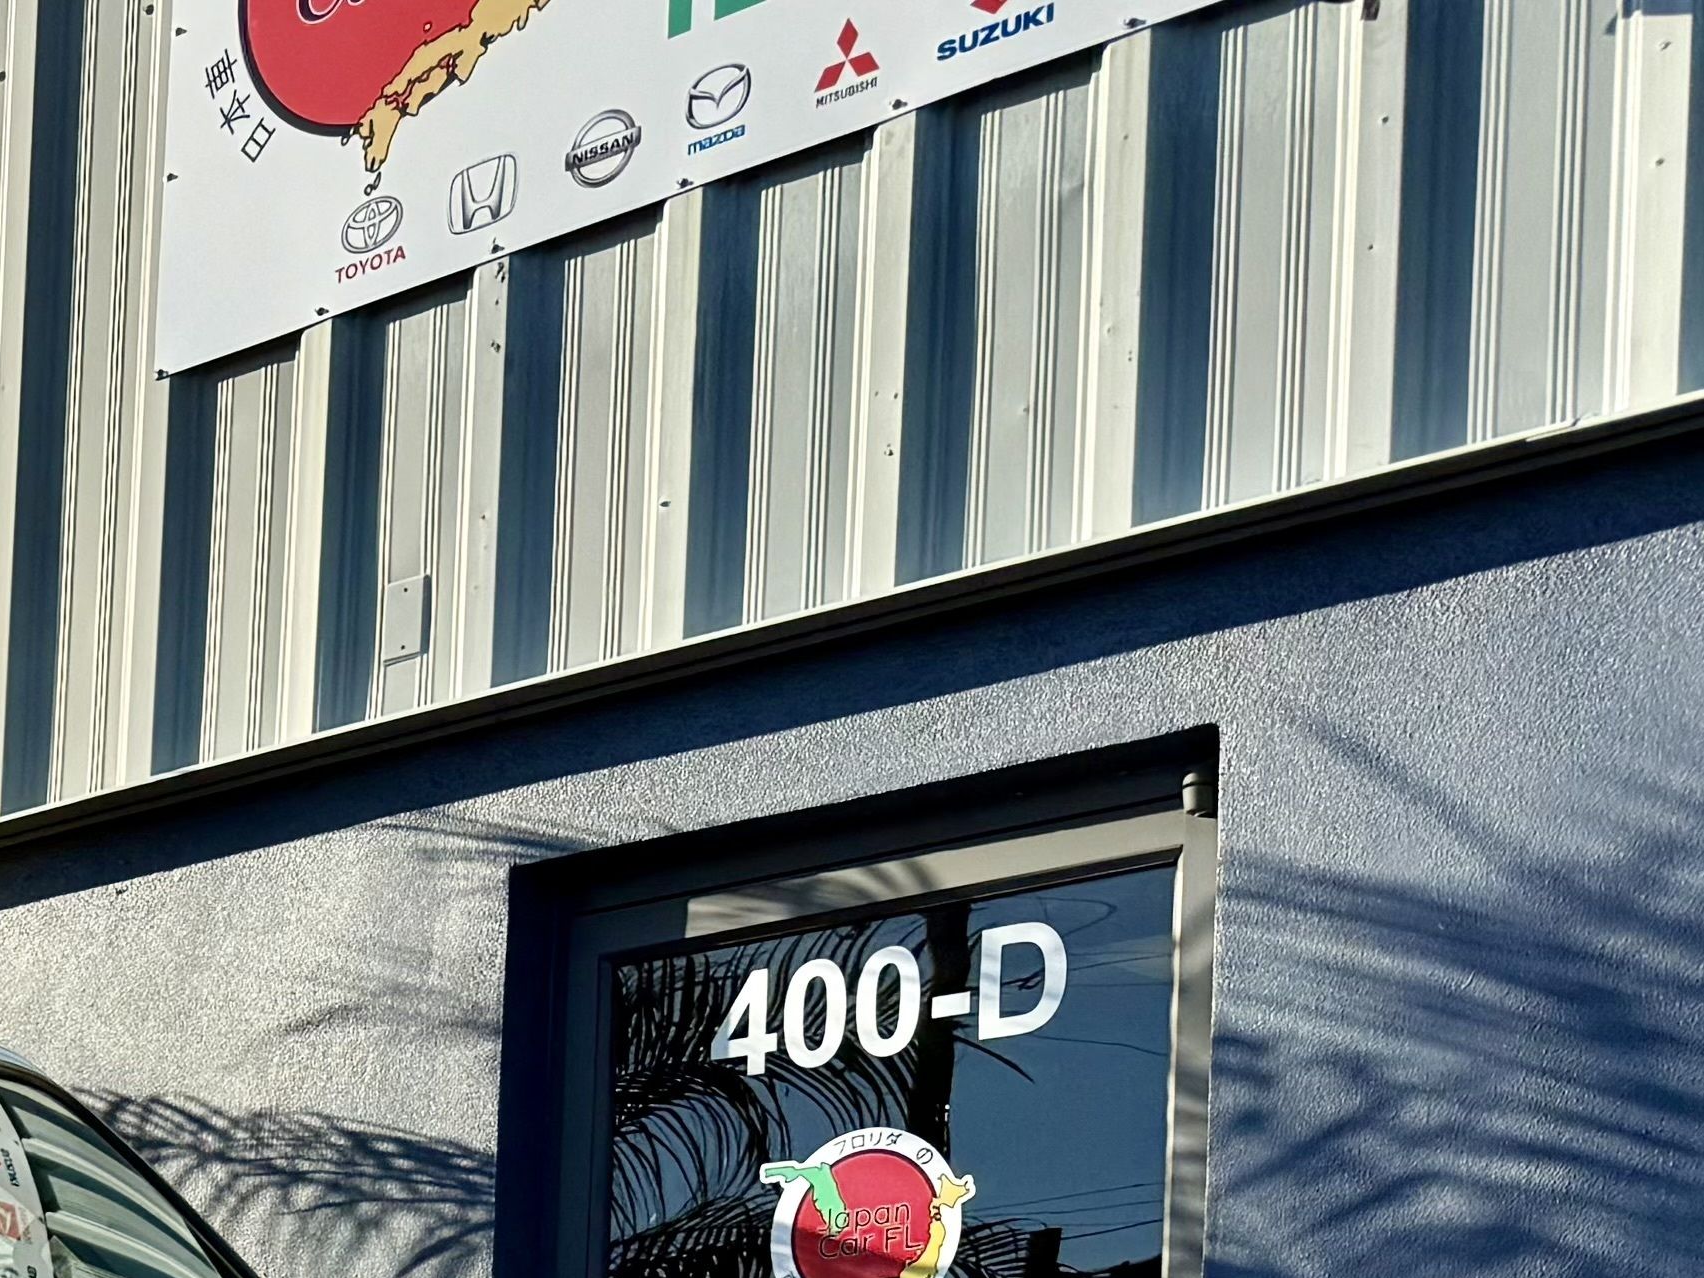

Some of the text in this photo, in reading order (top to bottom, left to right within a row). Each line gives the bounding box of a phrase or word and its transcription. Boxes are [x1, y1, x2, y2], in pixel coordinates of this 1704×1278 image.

[936, 3, 1055, 61] SUZUKI
[204, 48, 277, 164] 日本車
[815, 76, 879, 109] MITSUBISHI
[572, 132, 637, 166] NISSAN
[687, 124, 746, 156] mazda
[334, 245, 407, 284] TOYOTA
[710, 921, 1069, 1077] 400-D
[817, 1202, 911, 1236] Japan
[819, 1224, 925, 1259] Car FL
